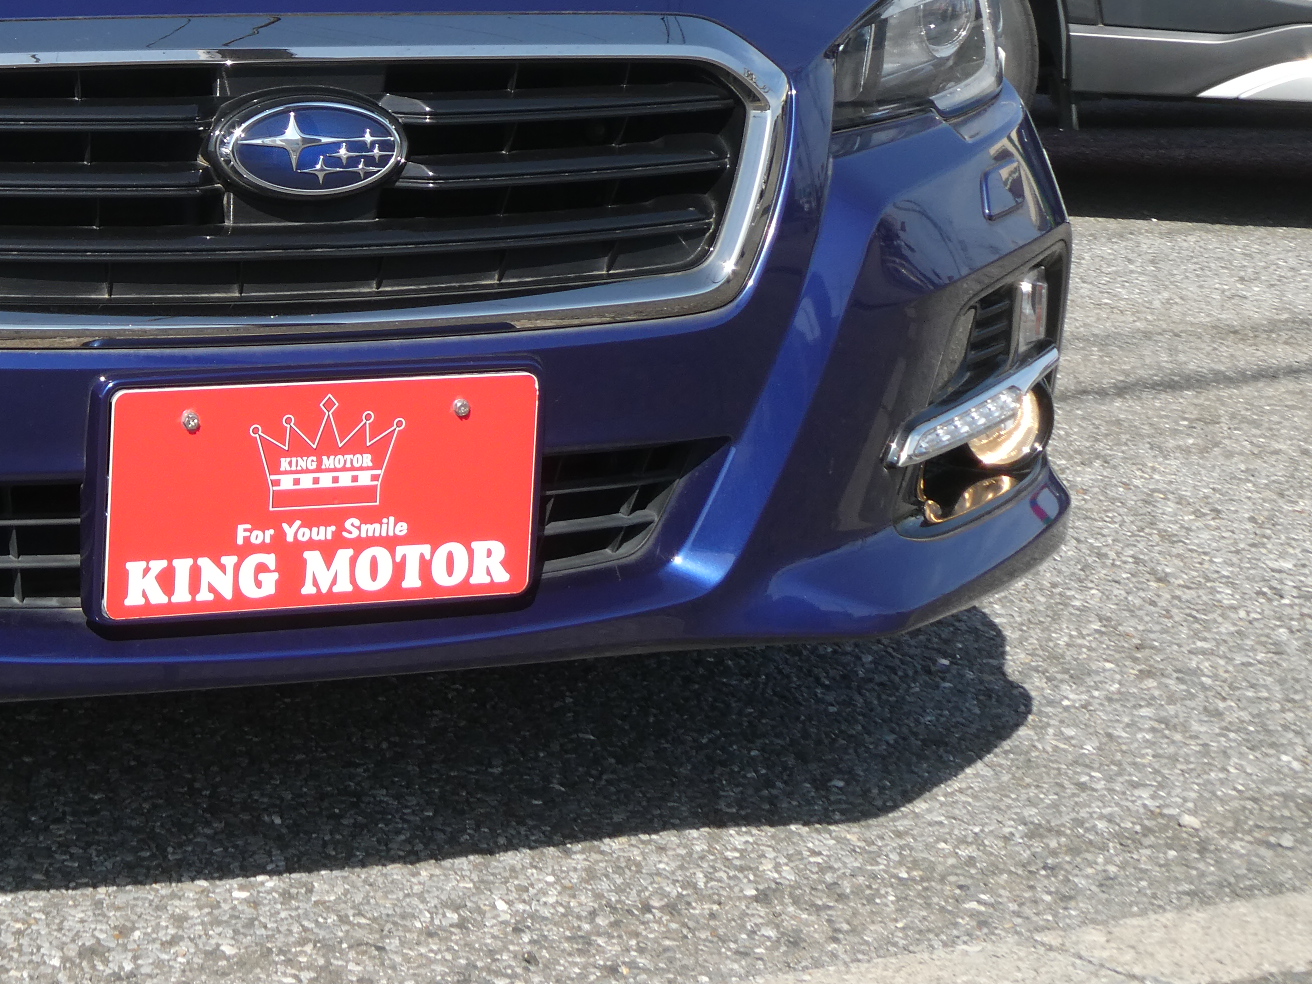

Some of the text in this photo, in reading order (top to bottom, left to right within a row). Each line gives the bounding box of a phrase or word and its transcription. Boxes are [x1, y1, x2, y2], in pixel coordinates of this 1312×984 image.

[280, 453, 373, 471] KING MOTOR
[236, 516, 408, 545] For Your Smile
[124, 539, 511, 606] KING MOTOR
